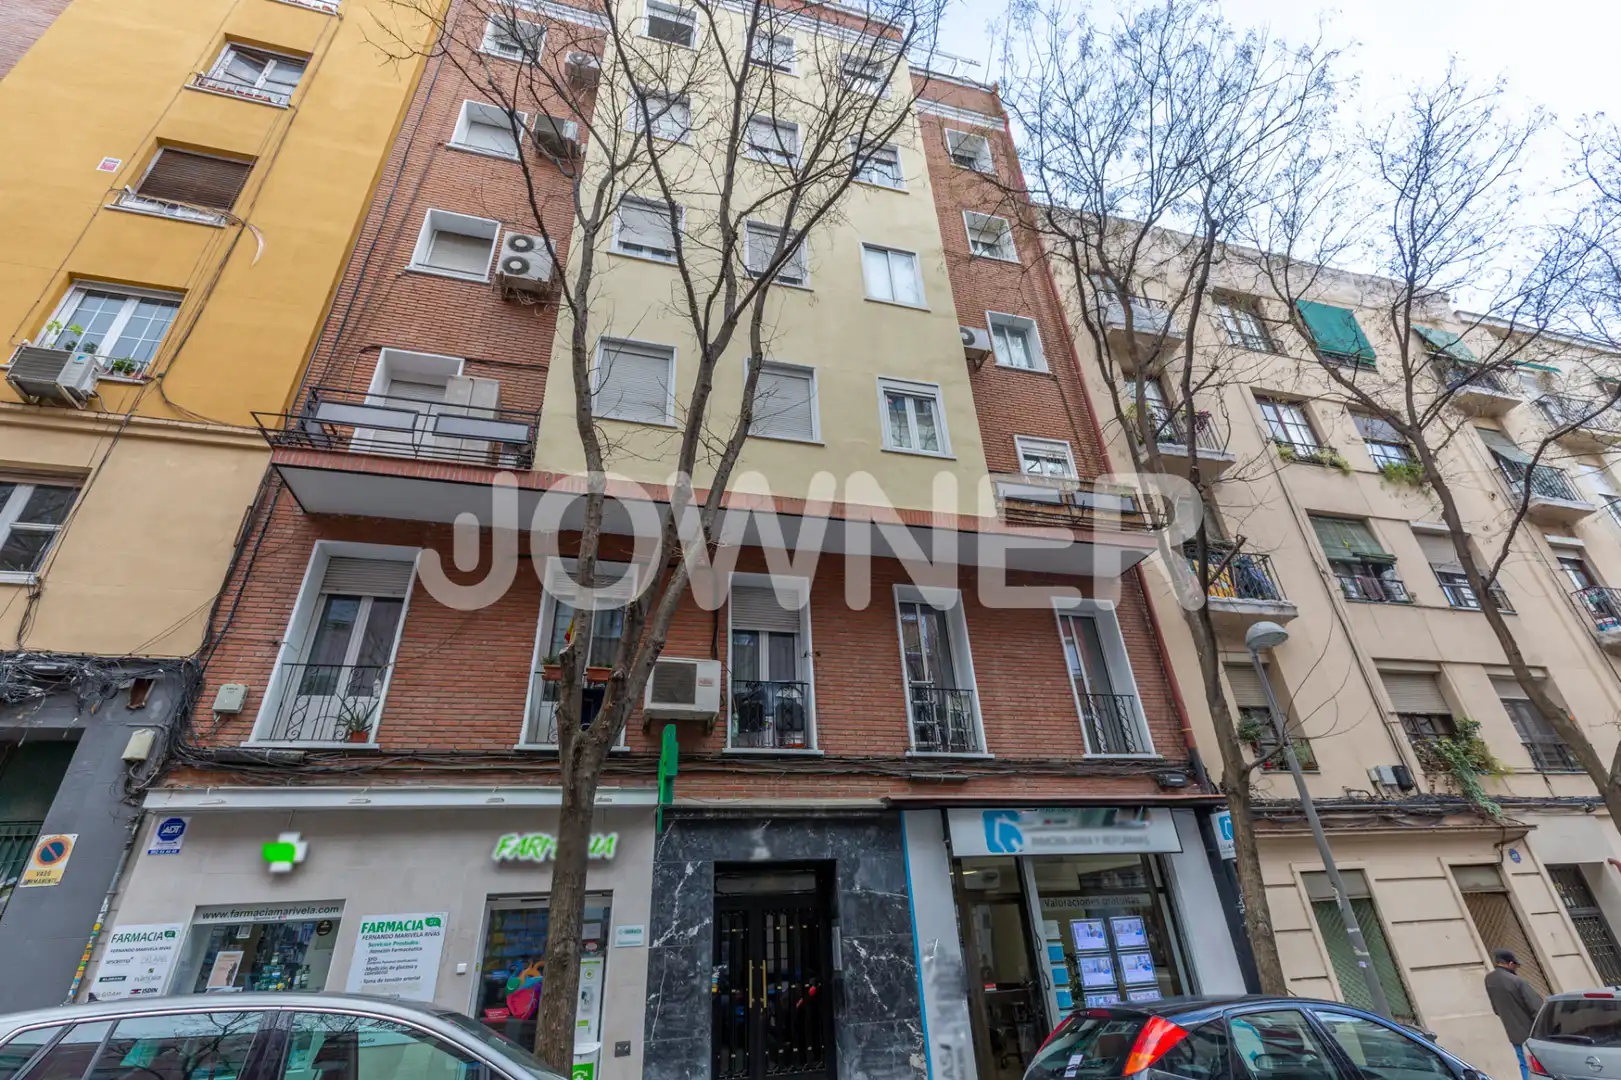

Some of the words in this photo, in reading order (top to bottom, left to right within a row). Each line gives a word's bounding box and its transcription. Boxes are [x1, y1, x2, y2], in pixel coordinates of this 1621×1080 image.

[161, 825, 182, 834] ADT
[492, 832, 618, 862] FARMIA
[202, 905, 339, 919] www.farmaciamarivela.com
[361, 919, 424, 934] FARMACIA
[110, 931, 163, 944] FARMACIA
[362, 933, 394, 941] FERNANDO
[395, 932, 423, 940] MARIVELA
